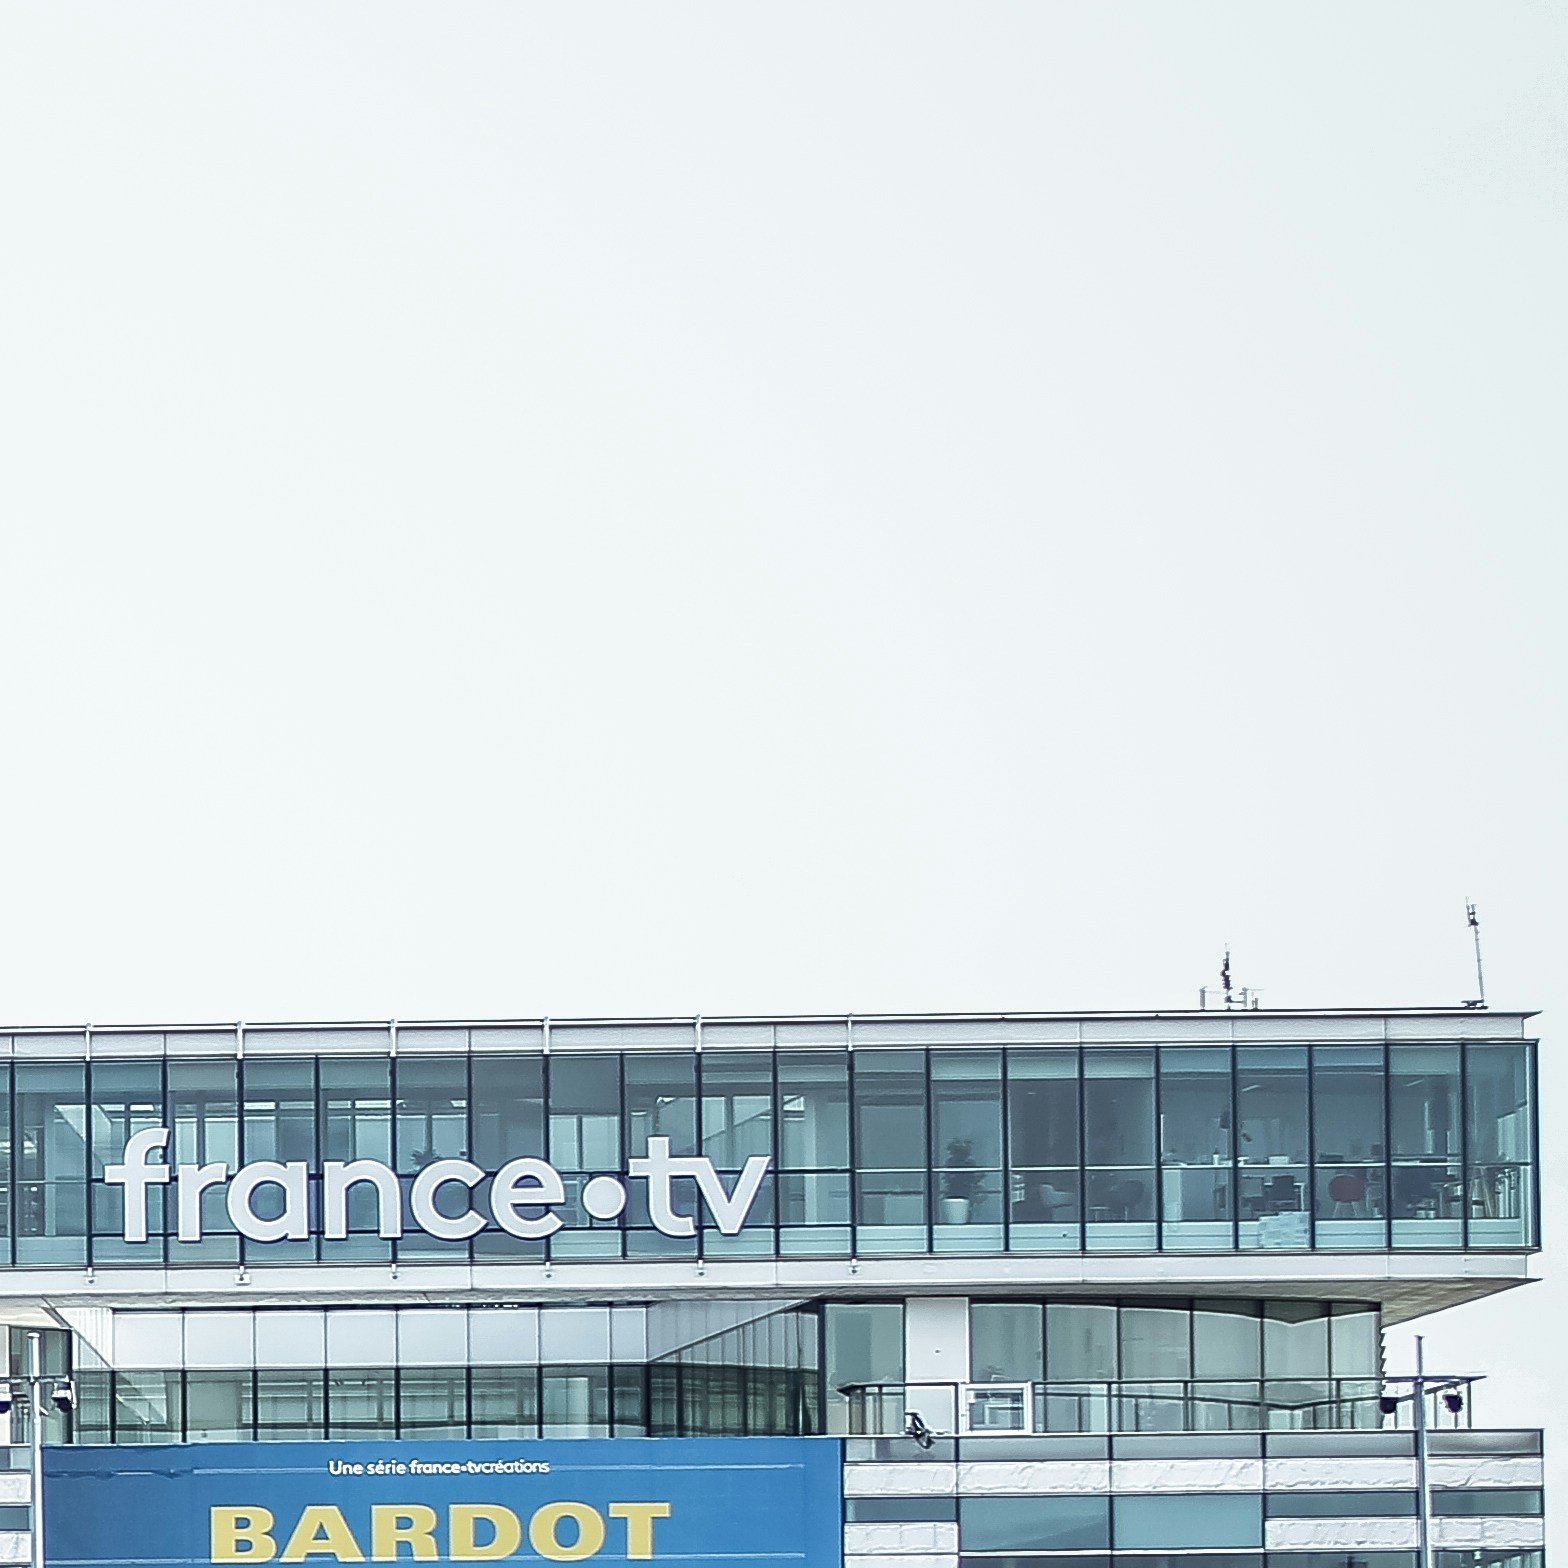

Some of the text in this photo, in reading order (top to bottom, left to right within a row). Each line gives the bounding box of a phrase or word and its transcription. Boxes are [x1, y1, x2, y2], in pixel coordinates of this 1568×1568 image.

[329, 1460, 364, 1475] Une
[366, 1459, 407, 1475] série
[210, 1501, 671, 1564] BARDOT
